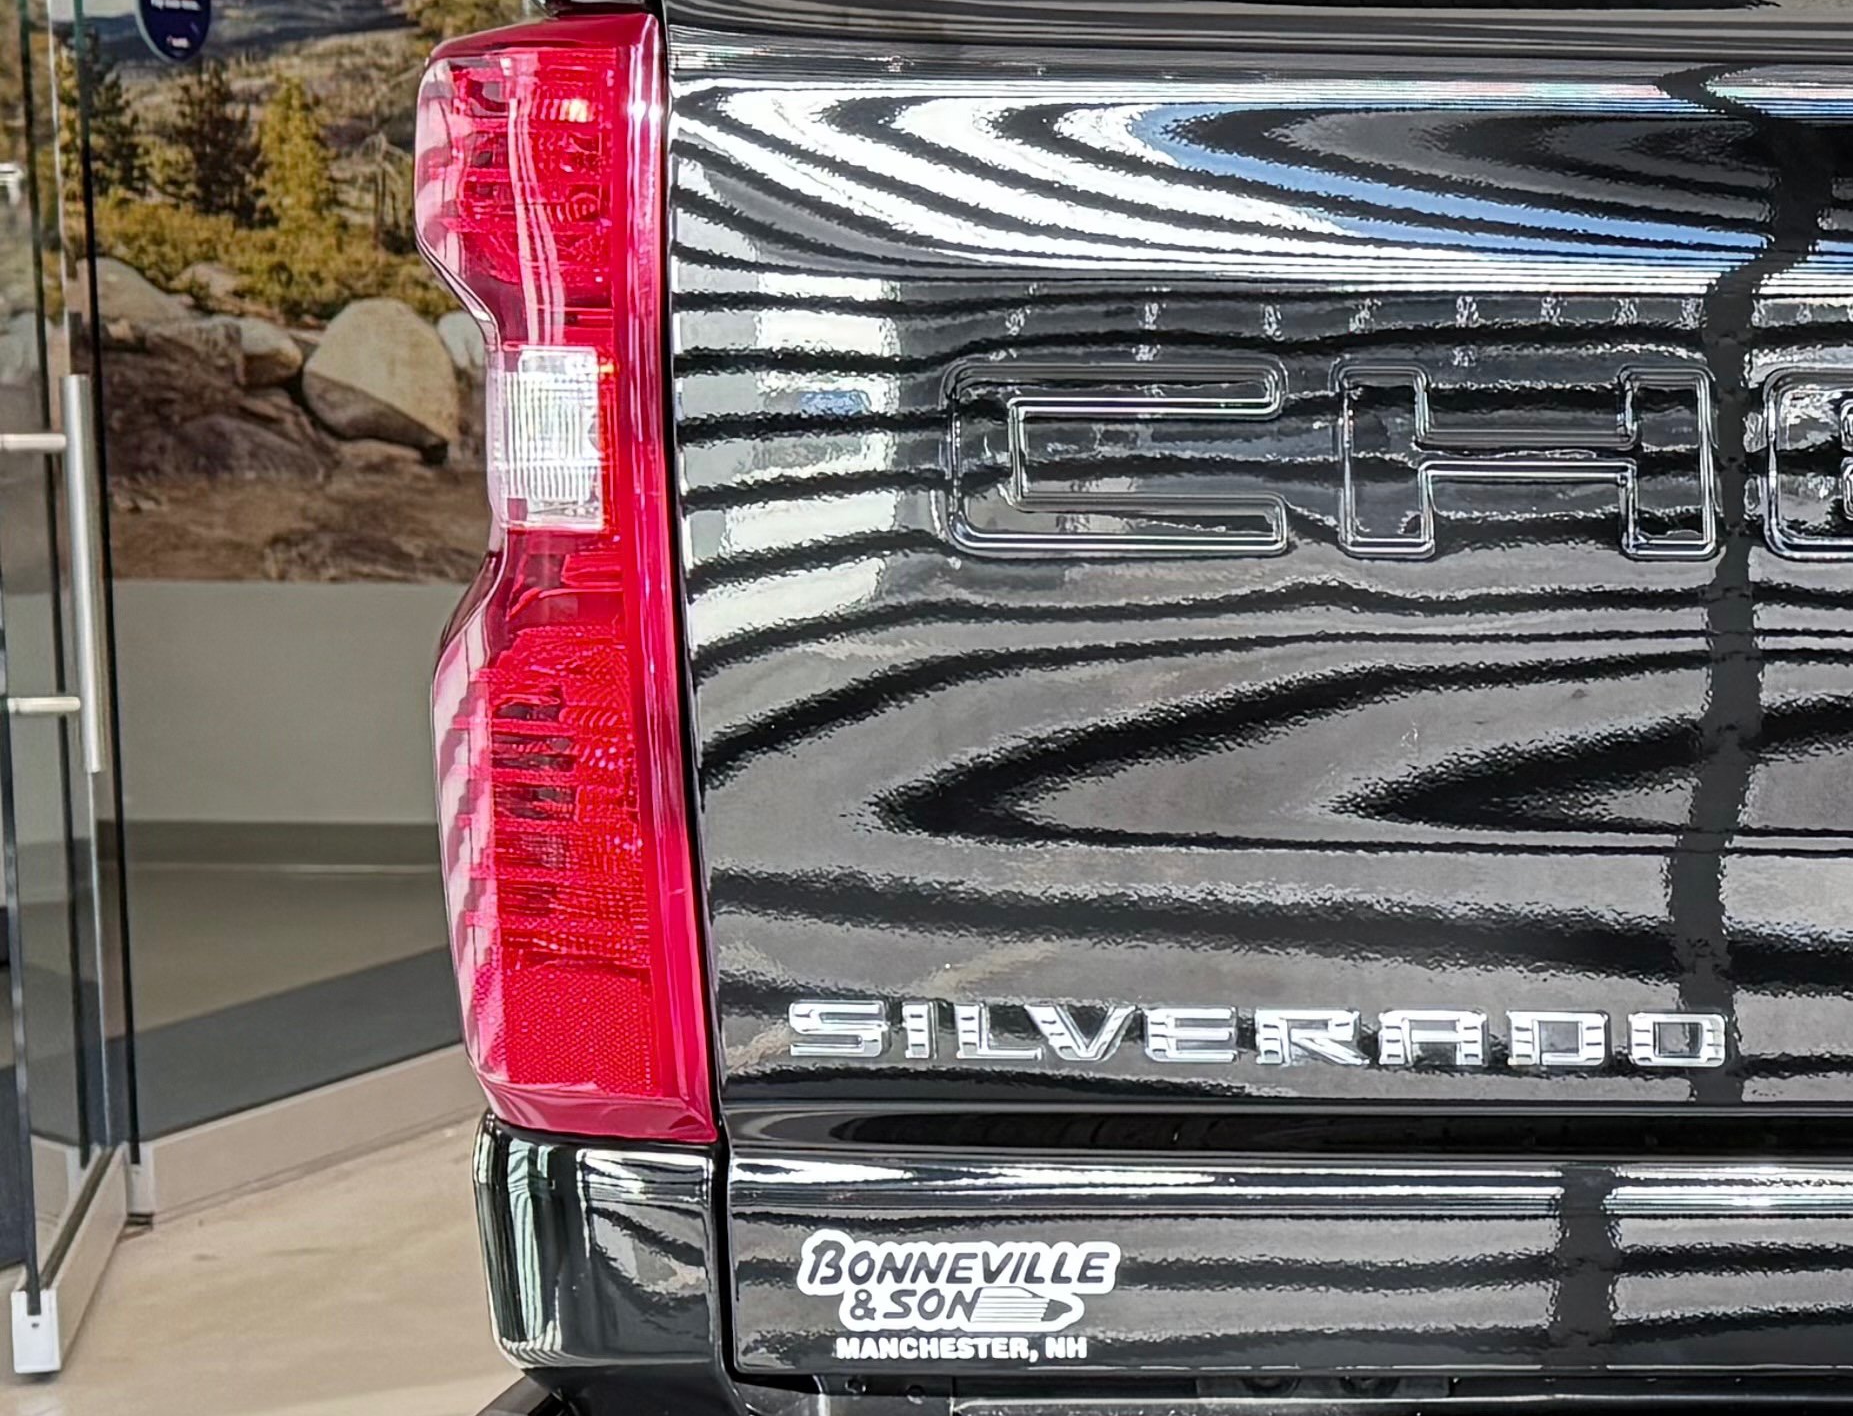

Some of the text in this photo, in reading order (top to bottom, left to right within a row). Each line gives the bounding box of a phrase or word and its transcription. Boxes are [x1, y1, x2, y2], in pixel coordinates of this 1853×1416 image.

[787, 998, 1733, 1069] SILVERADO
[807, 1239, 1110, 1285] BONNEVILLE
[849, 1287, 984, 1322] & SON
[836, 1337, 1088, 1363] MANCHESTER, NH
